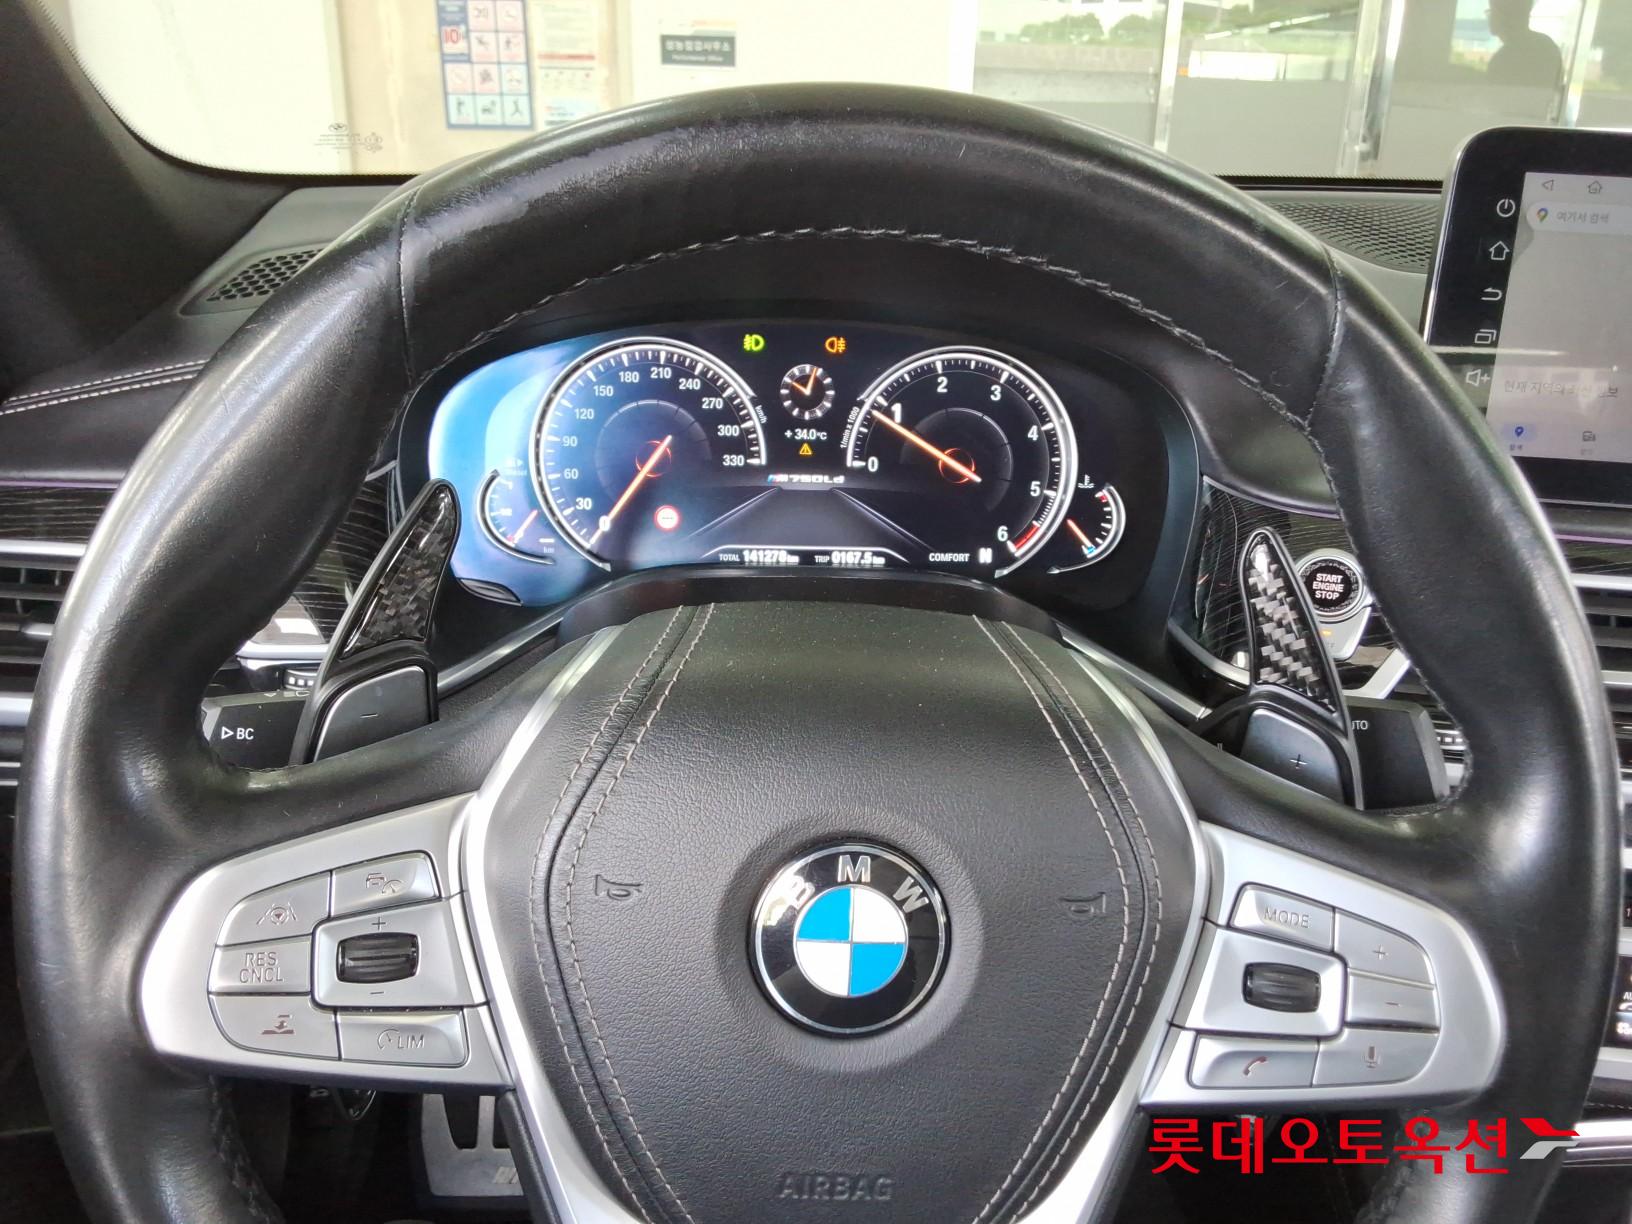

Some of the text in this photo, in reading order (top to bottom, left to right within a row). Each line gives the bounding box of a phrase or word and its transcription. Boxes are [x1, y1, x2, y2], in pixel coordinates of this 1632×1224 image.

[1556, 211, 1588, 223] 여기서
[618, 371, 640, 383] 180
[650, 367, 672, 379] 210
[593, 385, 614, 397] 150
[678, 378, 701, 391] 240
[937, 377, 948, 393] 2
[991, 385, 1001, 401] 3
[701, 397, 724, 410] 270
[574, 409, 595, 420] 120
[891, 403, 902, 422] 1
[717, 425, 739, 437] 300
[1027, 426, 1038, 440] 4
[563, 436, 578, 447] 90
[722, 455, 744, 467] 330
[867, 457, 878, 472] 0
[563, 469, 579, 480] 60
[1030, 481, 1040, 496] 5
[575, 498, 592, 510] 30
[600, 516, 610, 532] 0
[998, 526, 1008, 541] 6
[719, 553, 740, 562] TOTAL
[814, 555, 830, 563] TRIP
[929, 553, 970, 562] COMFORT
[1316, 573, 1343, 583] START
[1312, 582, 1345, 592] ENGINE
[1315, 591, 1340, 600] STOP
[236, 727, 254, 740] BC
[789, 855, 929, 913] BMW
[1263, 906, 1310, 929] MODE
[245, 952, 277, 967] RES
[239, 967, 284, 983] CNCL
[397, 1033, 425, 1050] LIM
[778, 1173, 894, 1201] AIRBAG
